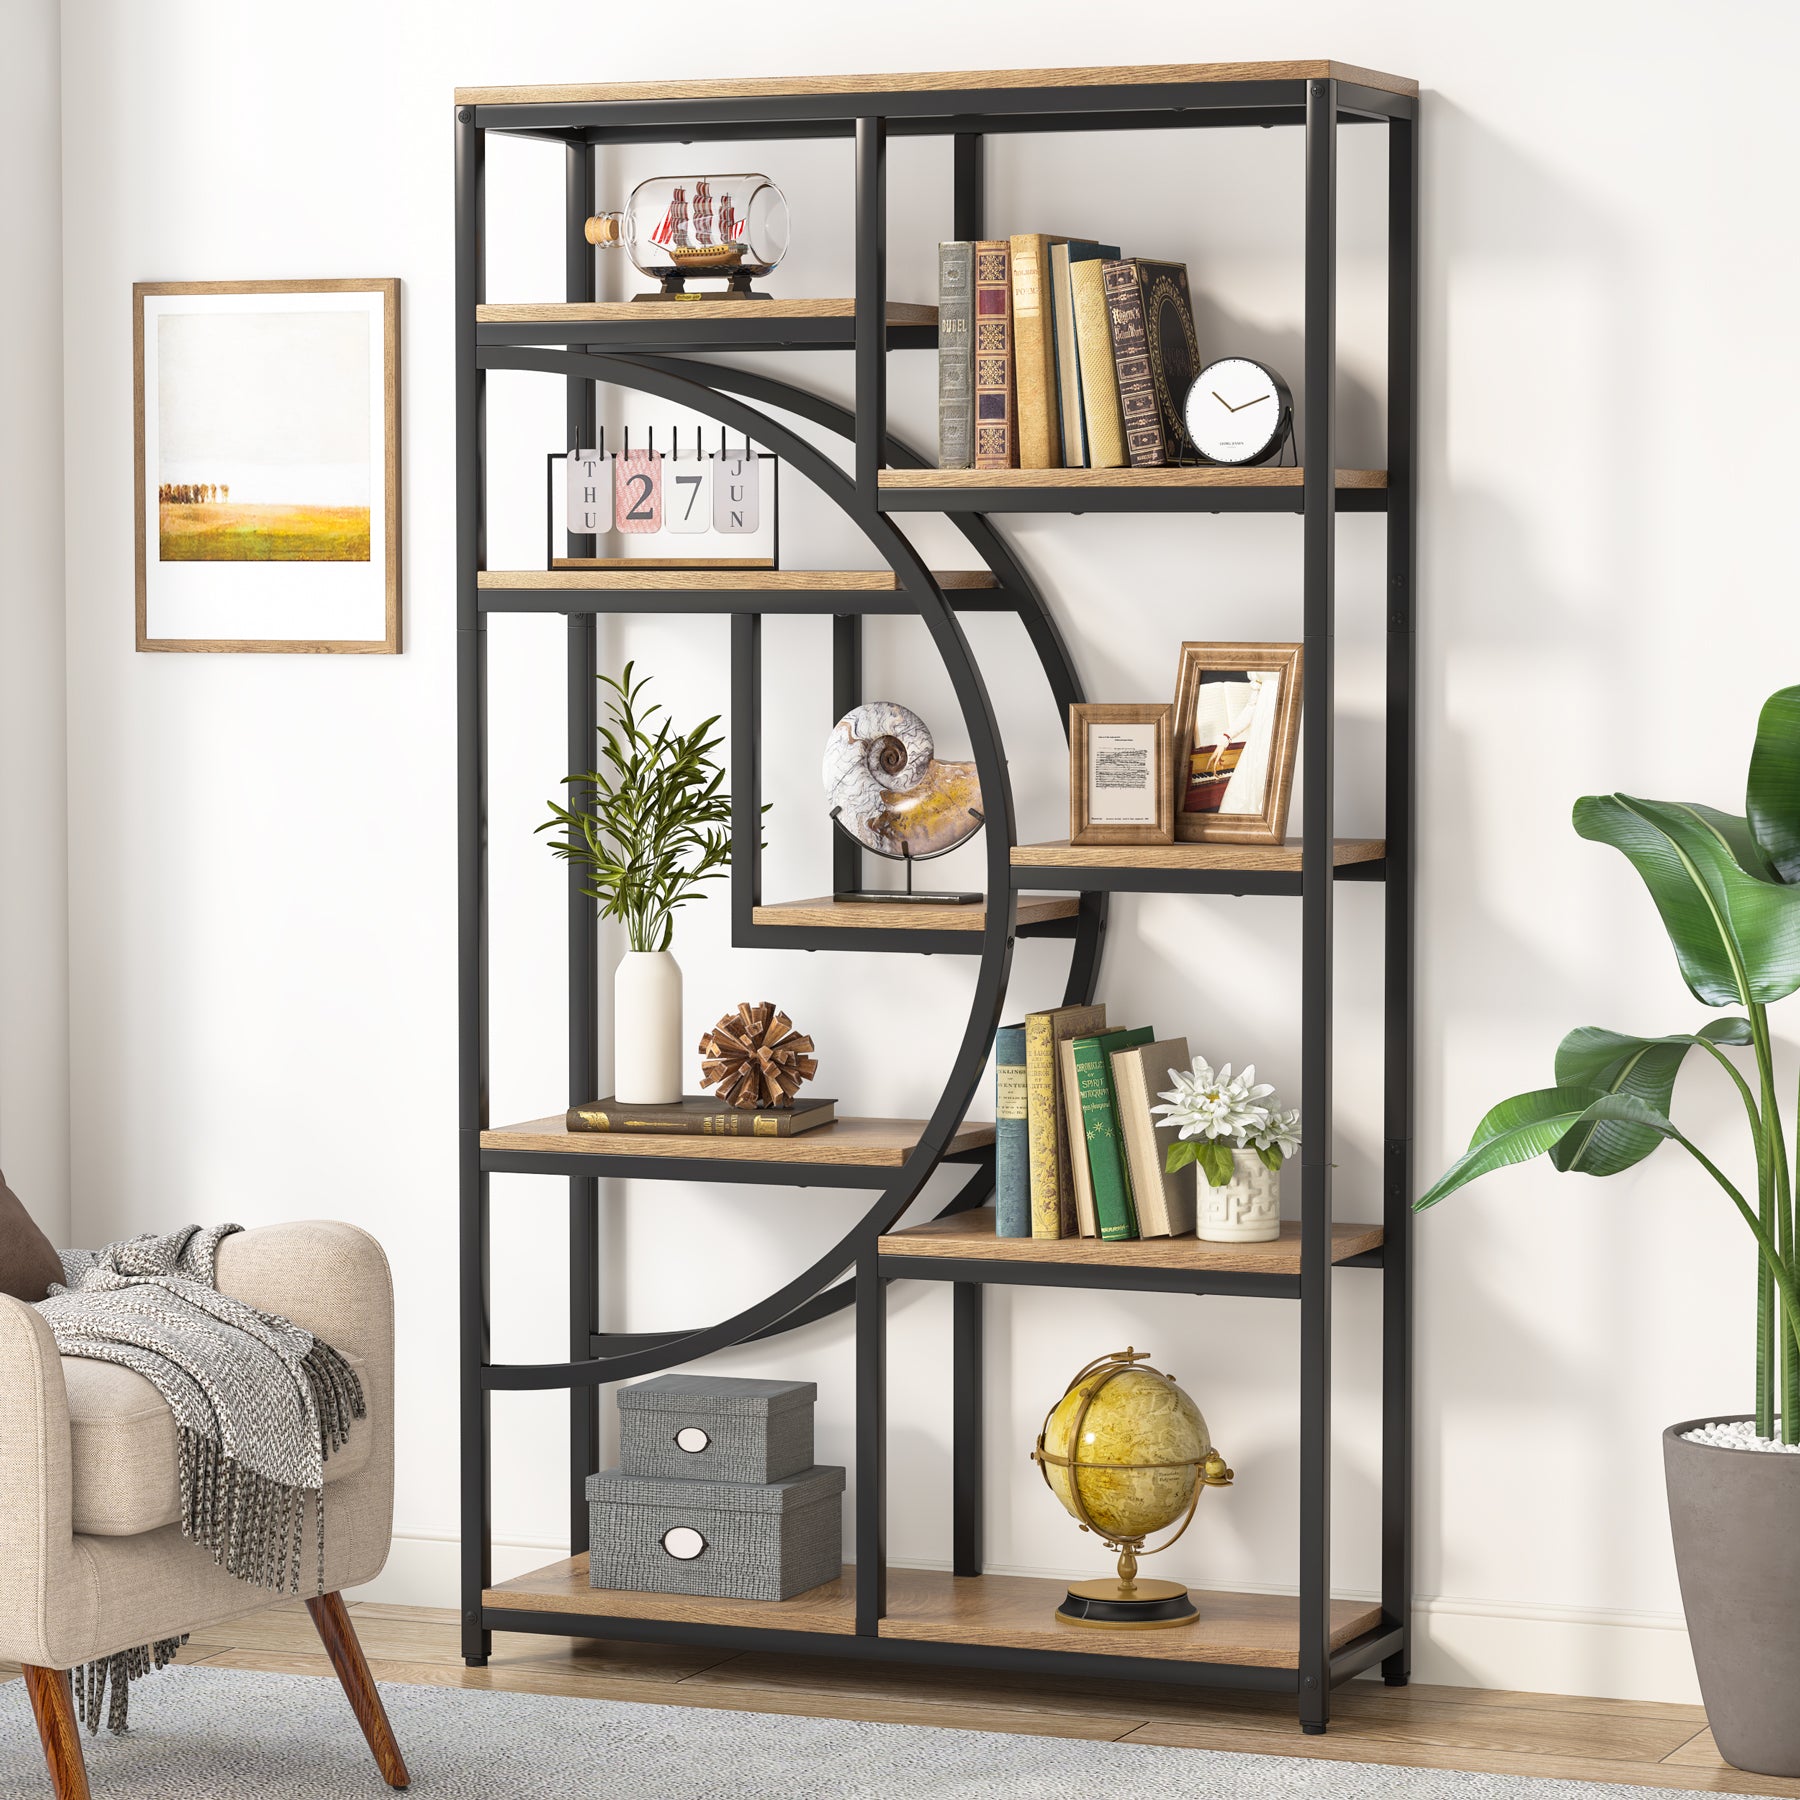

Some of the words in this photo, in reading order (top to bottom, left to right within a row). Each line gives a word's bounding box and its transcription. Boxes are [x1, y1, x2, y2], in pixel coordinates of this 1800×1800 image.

[583, 461, 597, 528] THU
[730, 460, 745, 528] JUN
[1081, 1078, 1105, 1089] SPIRIT
